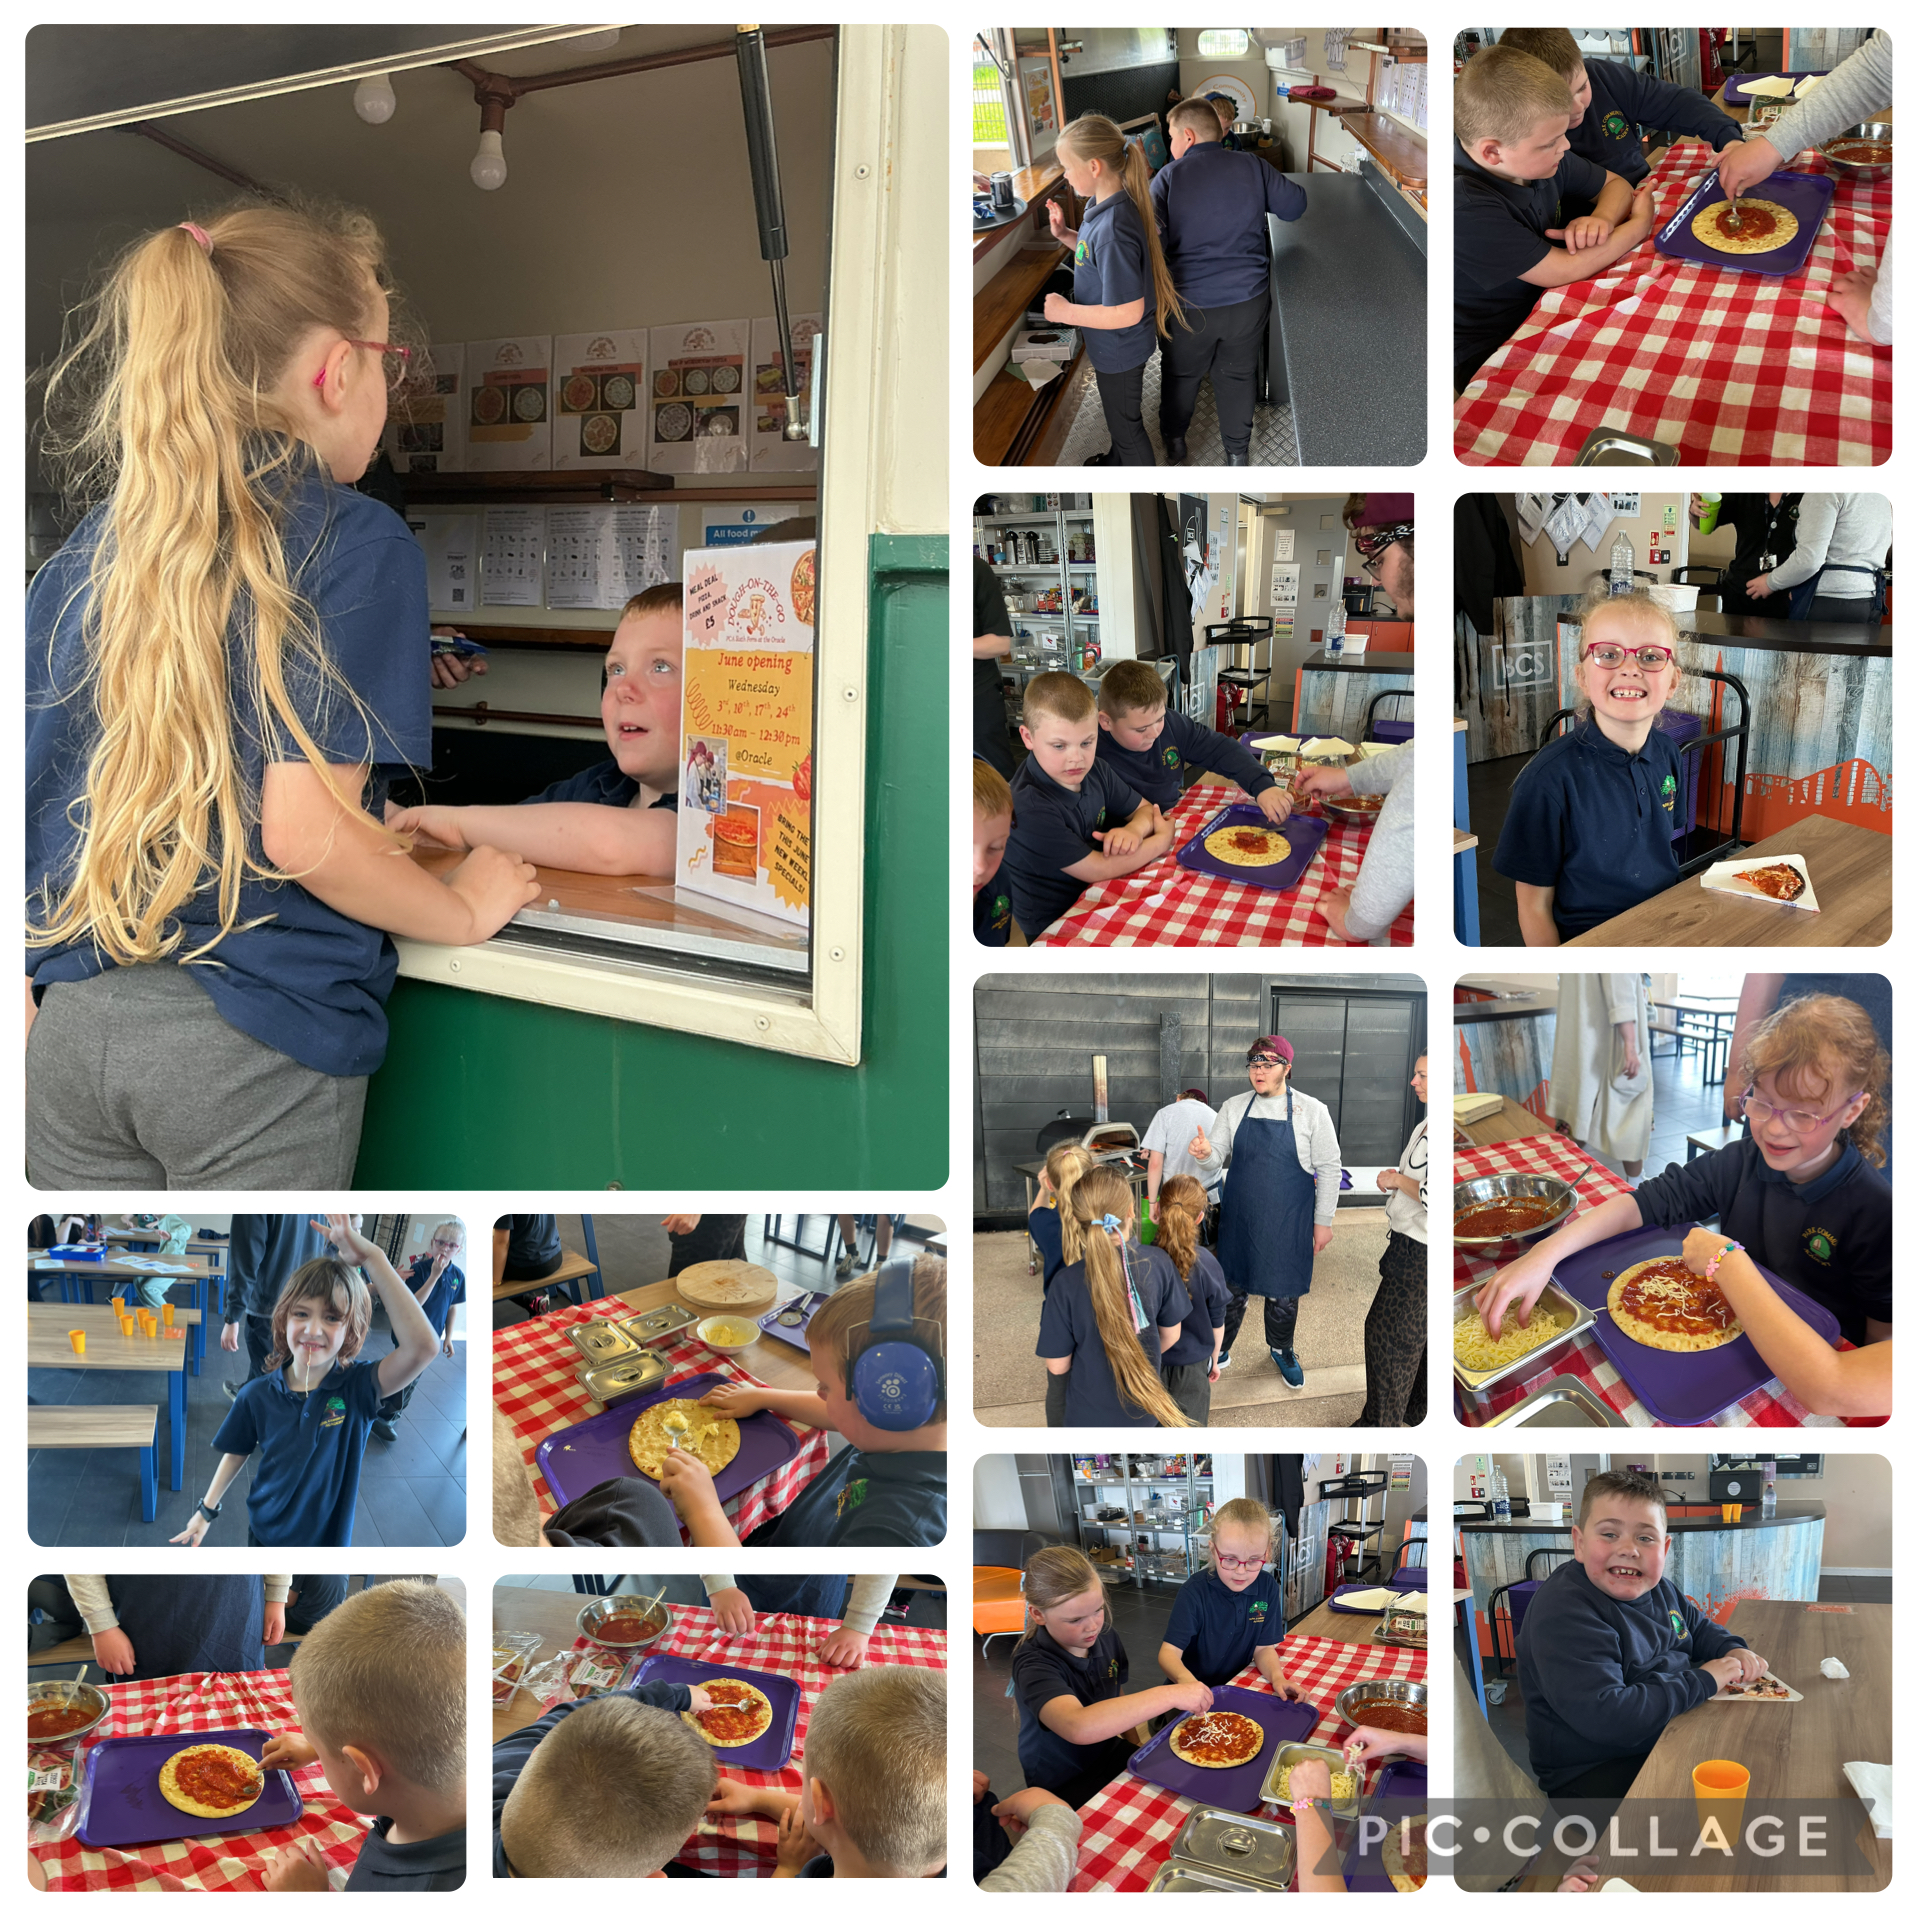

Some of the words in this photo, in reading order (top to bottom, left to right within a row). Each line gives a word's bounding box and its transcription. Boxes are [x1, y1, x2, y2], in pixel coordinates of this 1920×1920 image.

[1213, 83, 1247, 103] Community
[713, 529, 726, 538] All
[728, 529, 748, 538] food
[689, 582, 703, 596] MEAL
[704, 574, 718, 587] DEAL
[689, 608, 702, 620] DRINK
[702, 602, 711, 613] AND
[712, 594, 727, 607] SNACK
[705, 615, 715, 630] £5
[718, 652, 743, 668] June
[747, 654, 793, 675] opening
[1502, 651, 1545, 679] BCS
[728, 679, 780, 697] Wednesday
[735, 749, 773, 766] @Oracle
[777, 813, 796, 834] BRING
[796, 829, 810, 846] THE
[779, 830, 793, 848] THIS
[793, 845, 811, 864] JUNE
[774, 844, 788, 861] NEW
[789, 858, 809, 884] WEEKL
[774, 861, 806, 895] SPECIALS!
